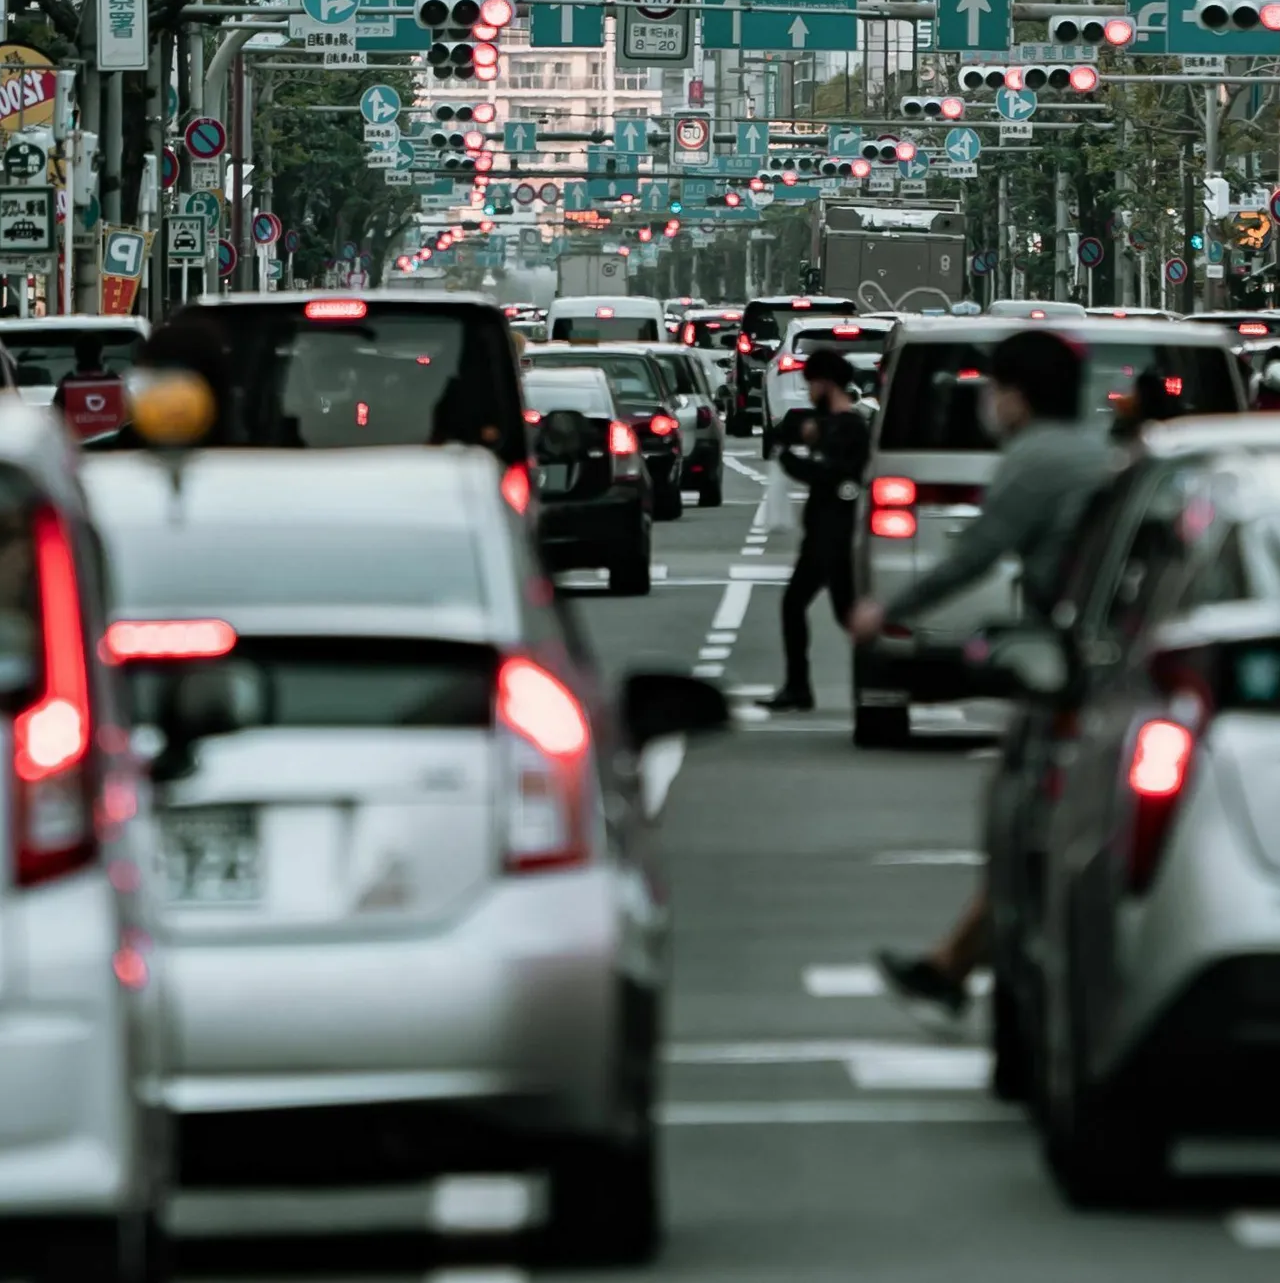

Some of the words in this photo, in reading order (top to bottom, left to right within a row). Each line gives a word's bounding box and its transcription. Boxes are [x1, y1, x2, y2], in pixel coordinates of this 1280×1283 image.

[306, 33, 354, 47] 自転車を除く
[1022, 45, 1095, 60] 時差信号
[683, 125, 701, 140] 50
[172, 223, 200, 231] TAXI
